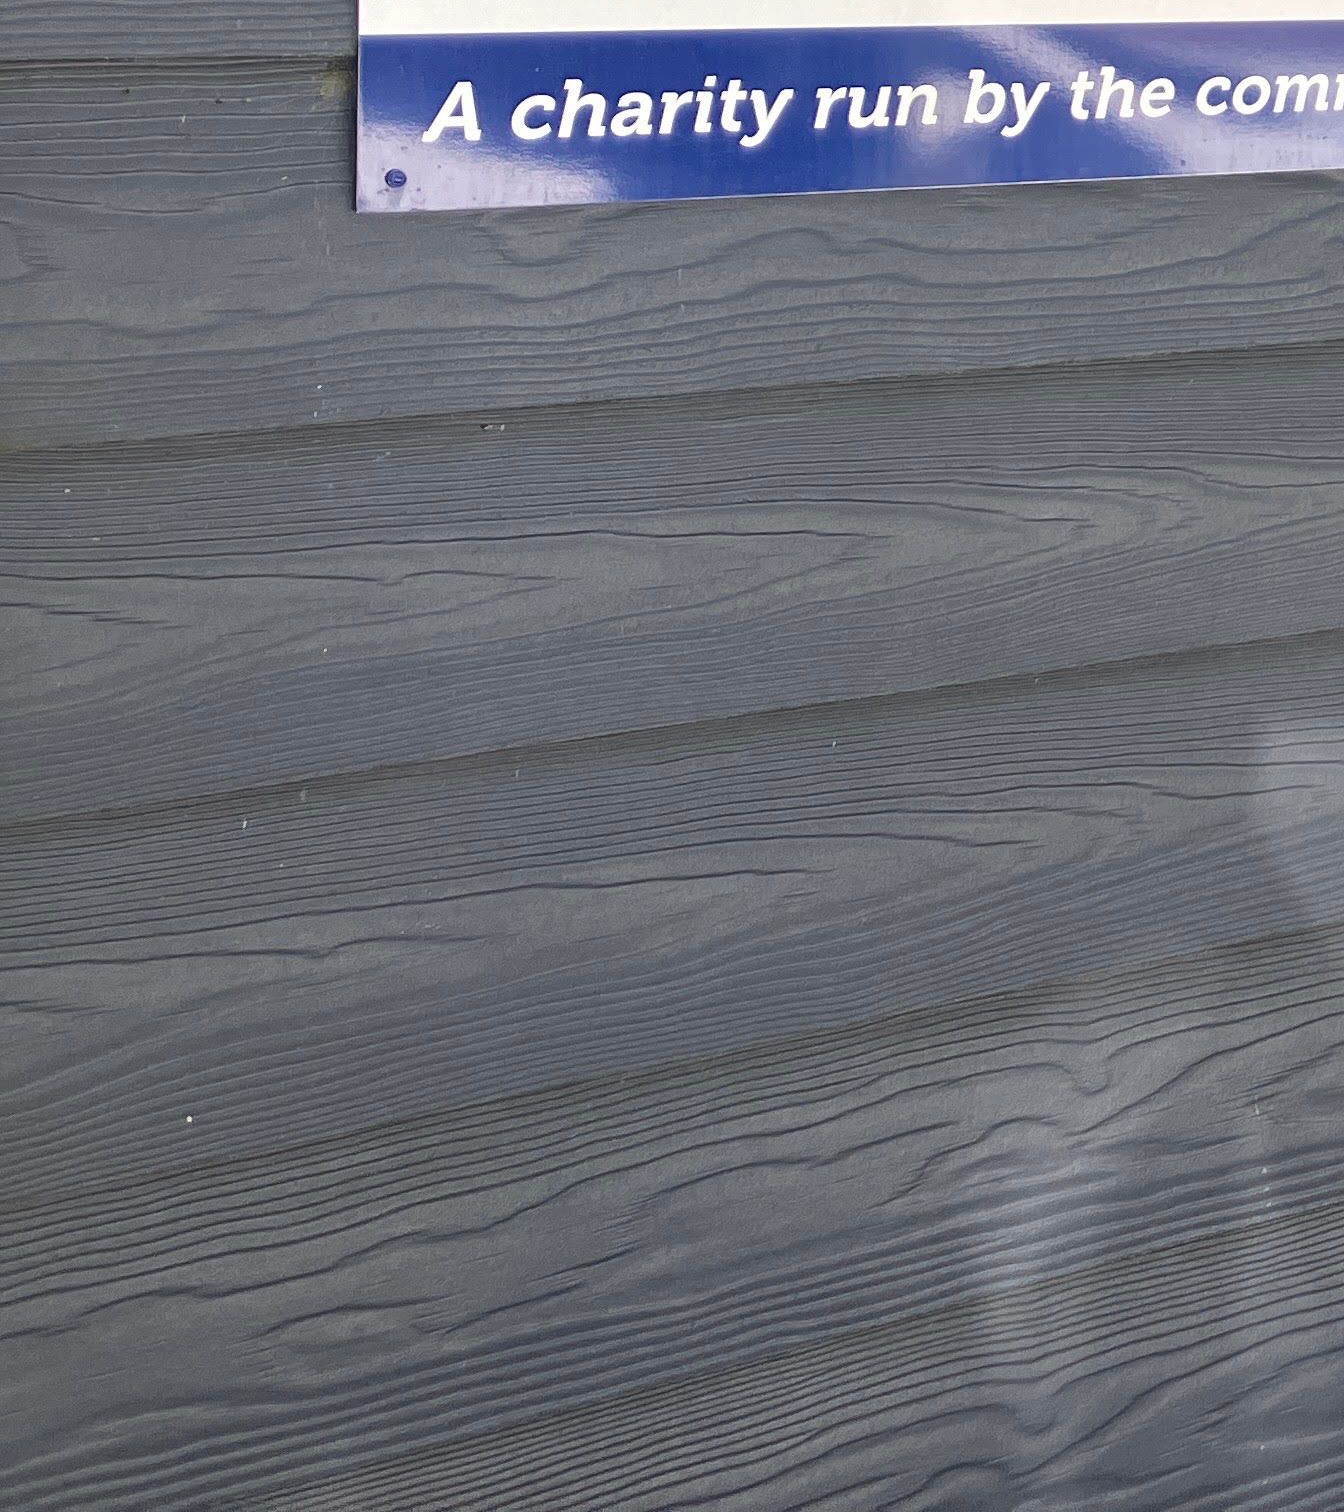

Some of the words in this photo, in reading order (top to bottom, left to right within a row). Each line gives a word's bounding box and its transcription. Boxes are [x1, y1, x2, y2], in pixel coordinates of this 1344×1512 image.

[421, 81, 482, 143] A
[509, 76, 796, 149] charity
[813, 86, 938, 130] run
[962, 69, 1051, 138] by
[1070, 66, 1176, 120] the
